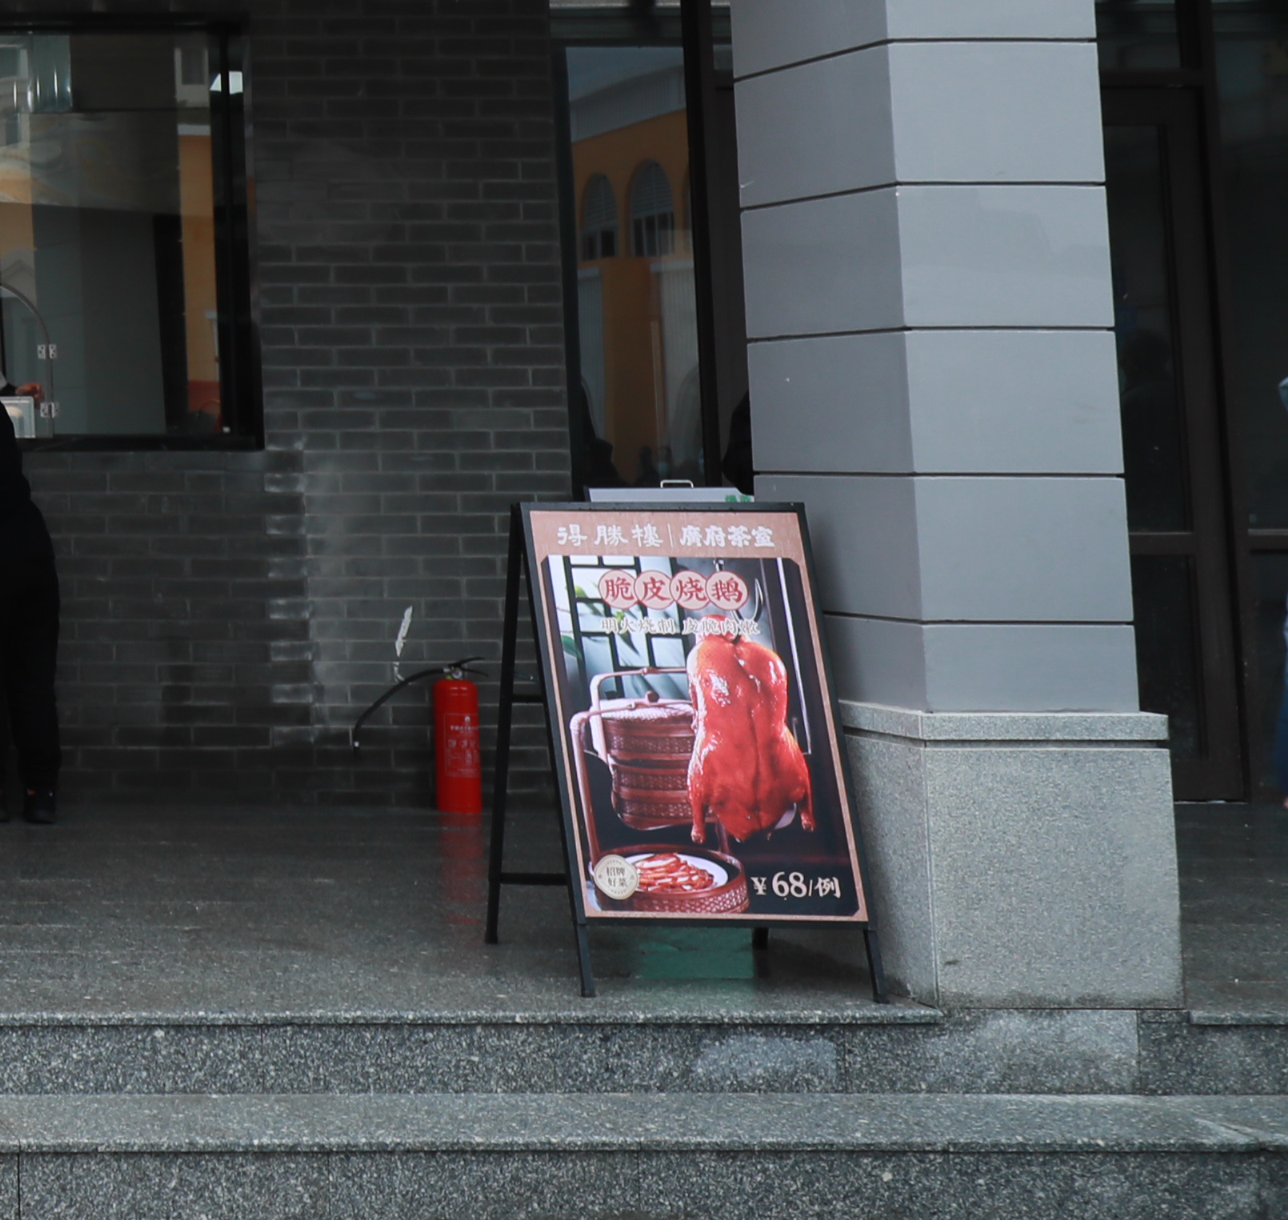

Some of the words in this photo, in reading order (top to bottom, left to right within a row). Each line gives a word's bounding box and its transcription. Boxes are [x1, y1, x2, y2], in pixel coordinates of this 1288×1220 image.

[680, 525, 775, 548] 廣府茶室
[605, 577, 743, 604] 脆皮烧鹅
